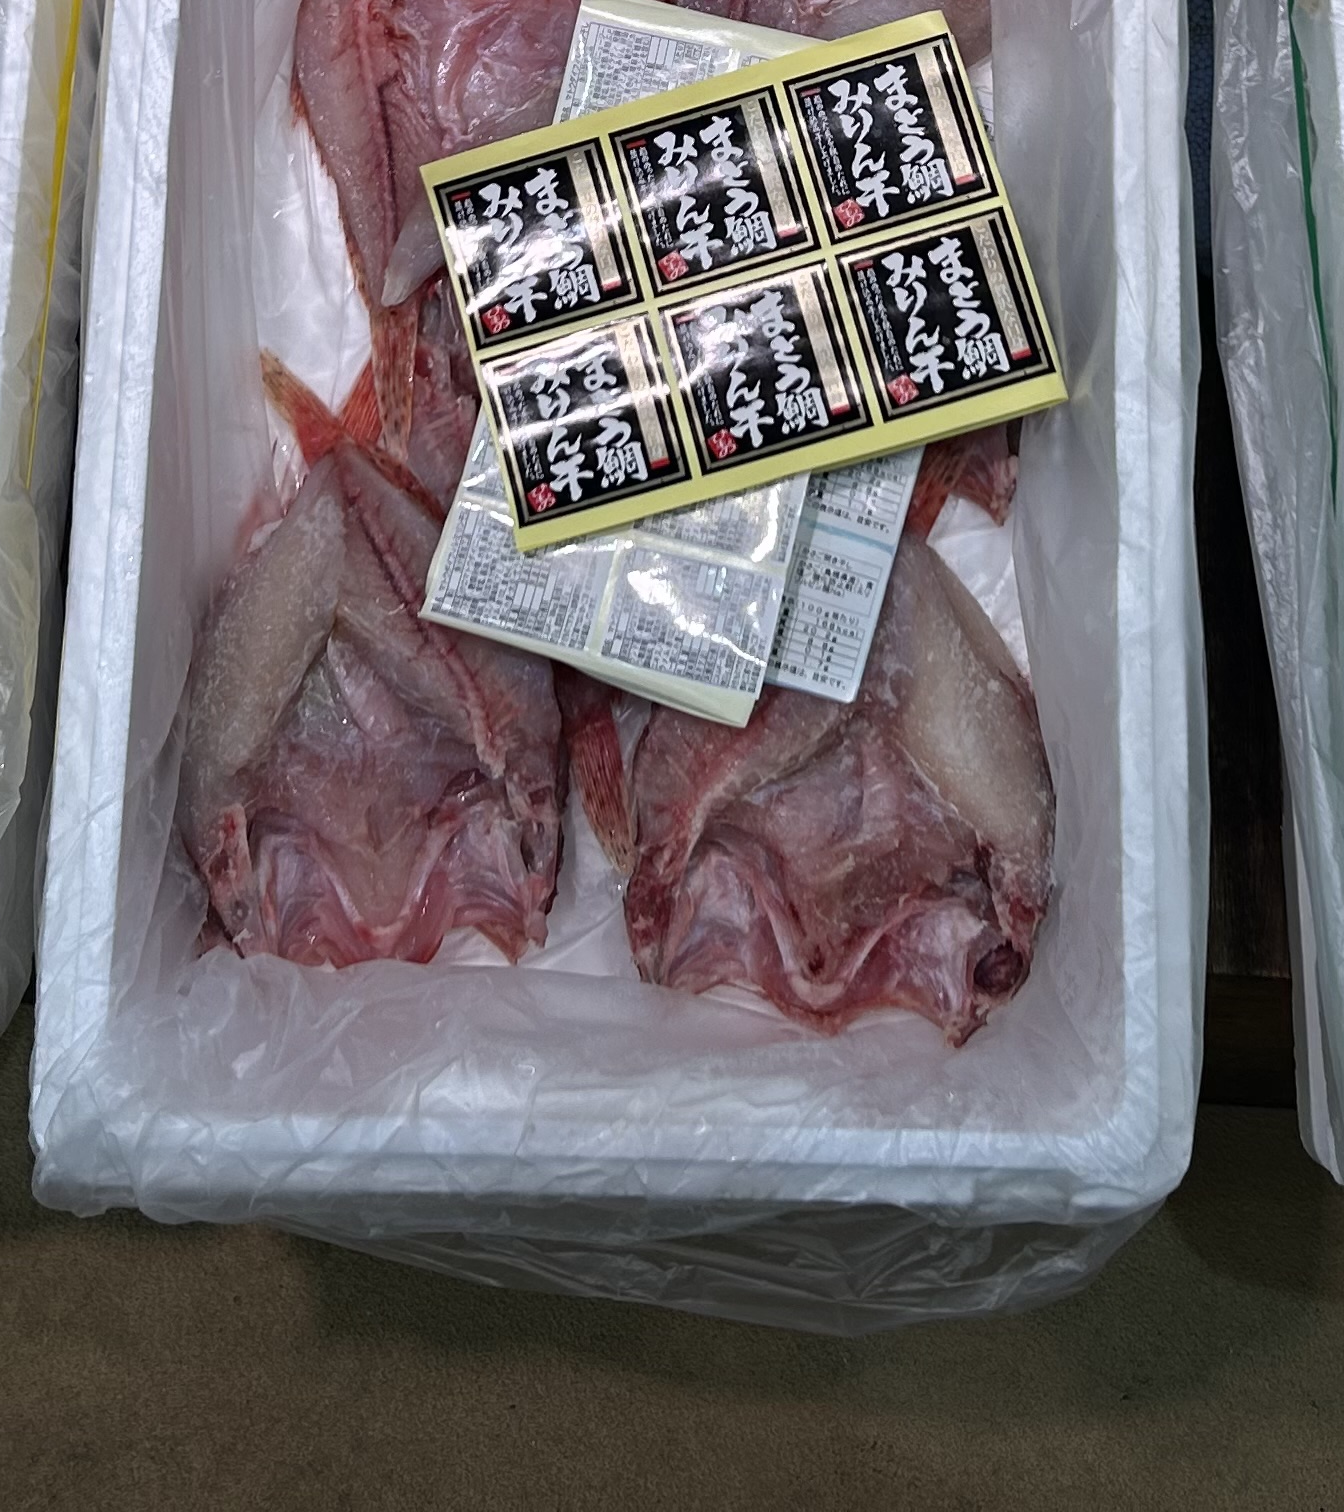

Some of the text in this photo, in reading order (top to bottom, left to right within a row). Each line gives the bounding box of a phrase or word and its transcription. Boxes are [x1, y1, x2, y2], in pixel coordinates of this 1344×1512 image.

[699, 116, 777, 258] まとう鯛
[874, 64, 953, 205] まとう鯛
[750, 290, 829, 434] まとう鯛
[927, 238, 1012, 379] まとう鯛
